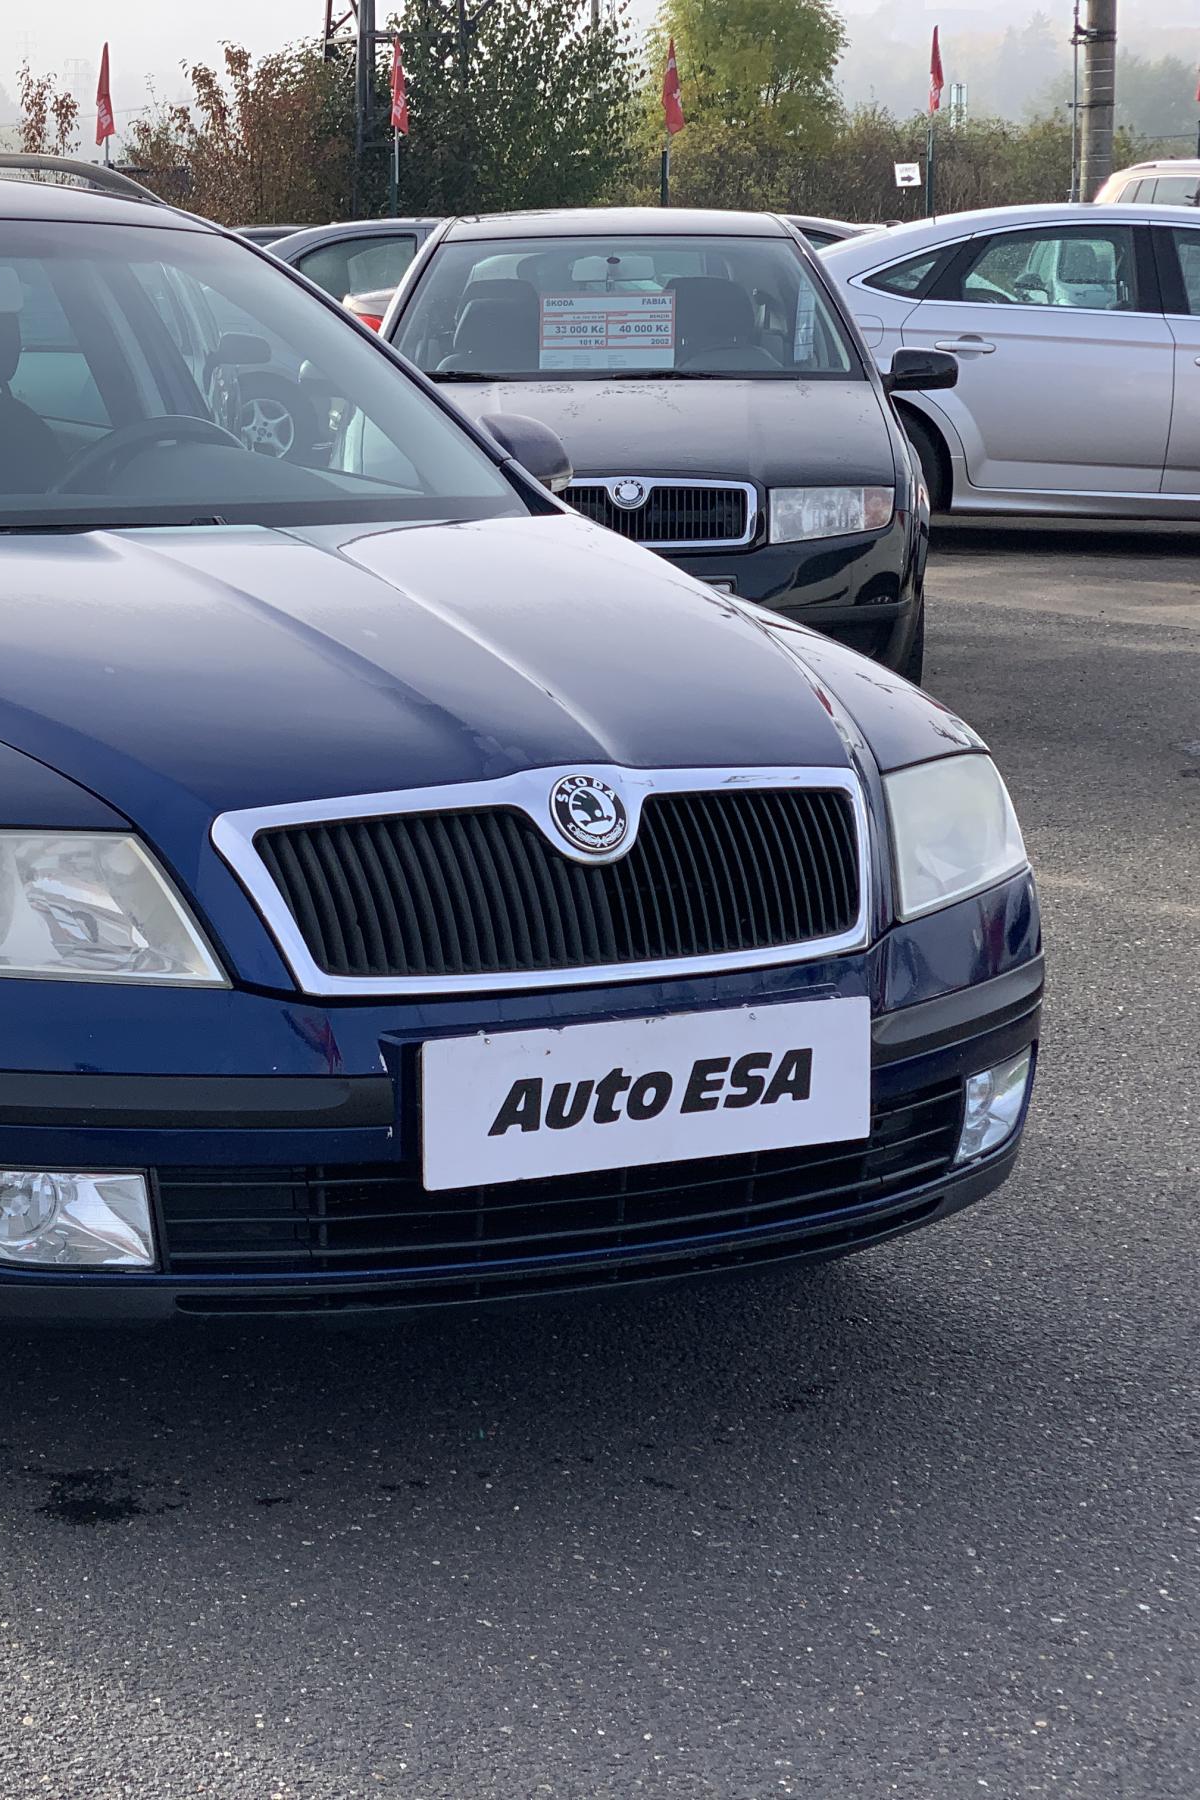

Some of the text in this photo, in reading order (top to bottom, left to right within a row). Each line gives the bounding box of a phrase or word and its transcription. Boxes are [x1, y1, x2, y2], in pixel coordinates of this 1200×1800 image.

[641, 297, 667, 305] FABIA
[569, 325, 588, 334] 000
[618, 325, 632, 333] 40
[634, 324, 653, 333] 000
[487, 1048, 813, 1137] Auto ESA
